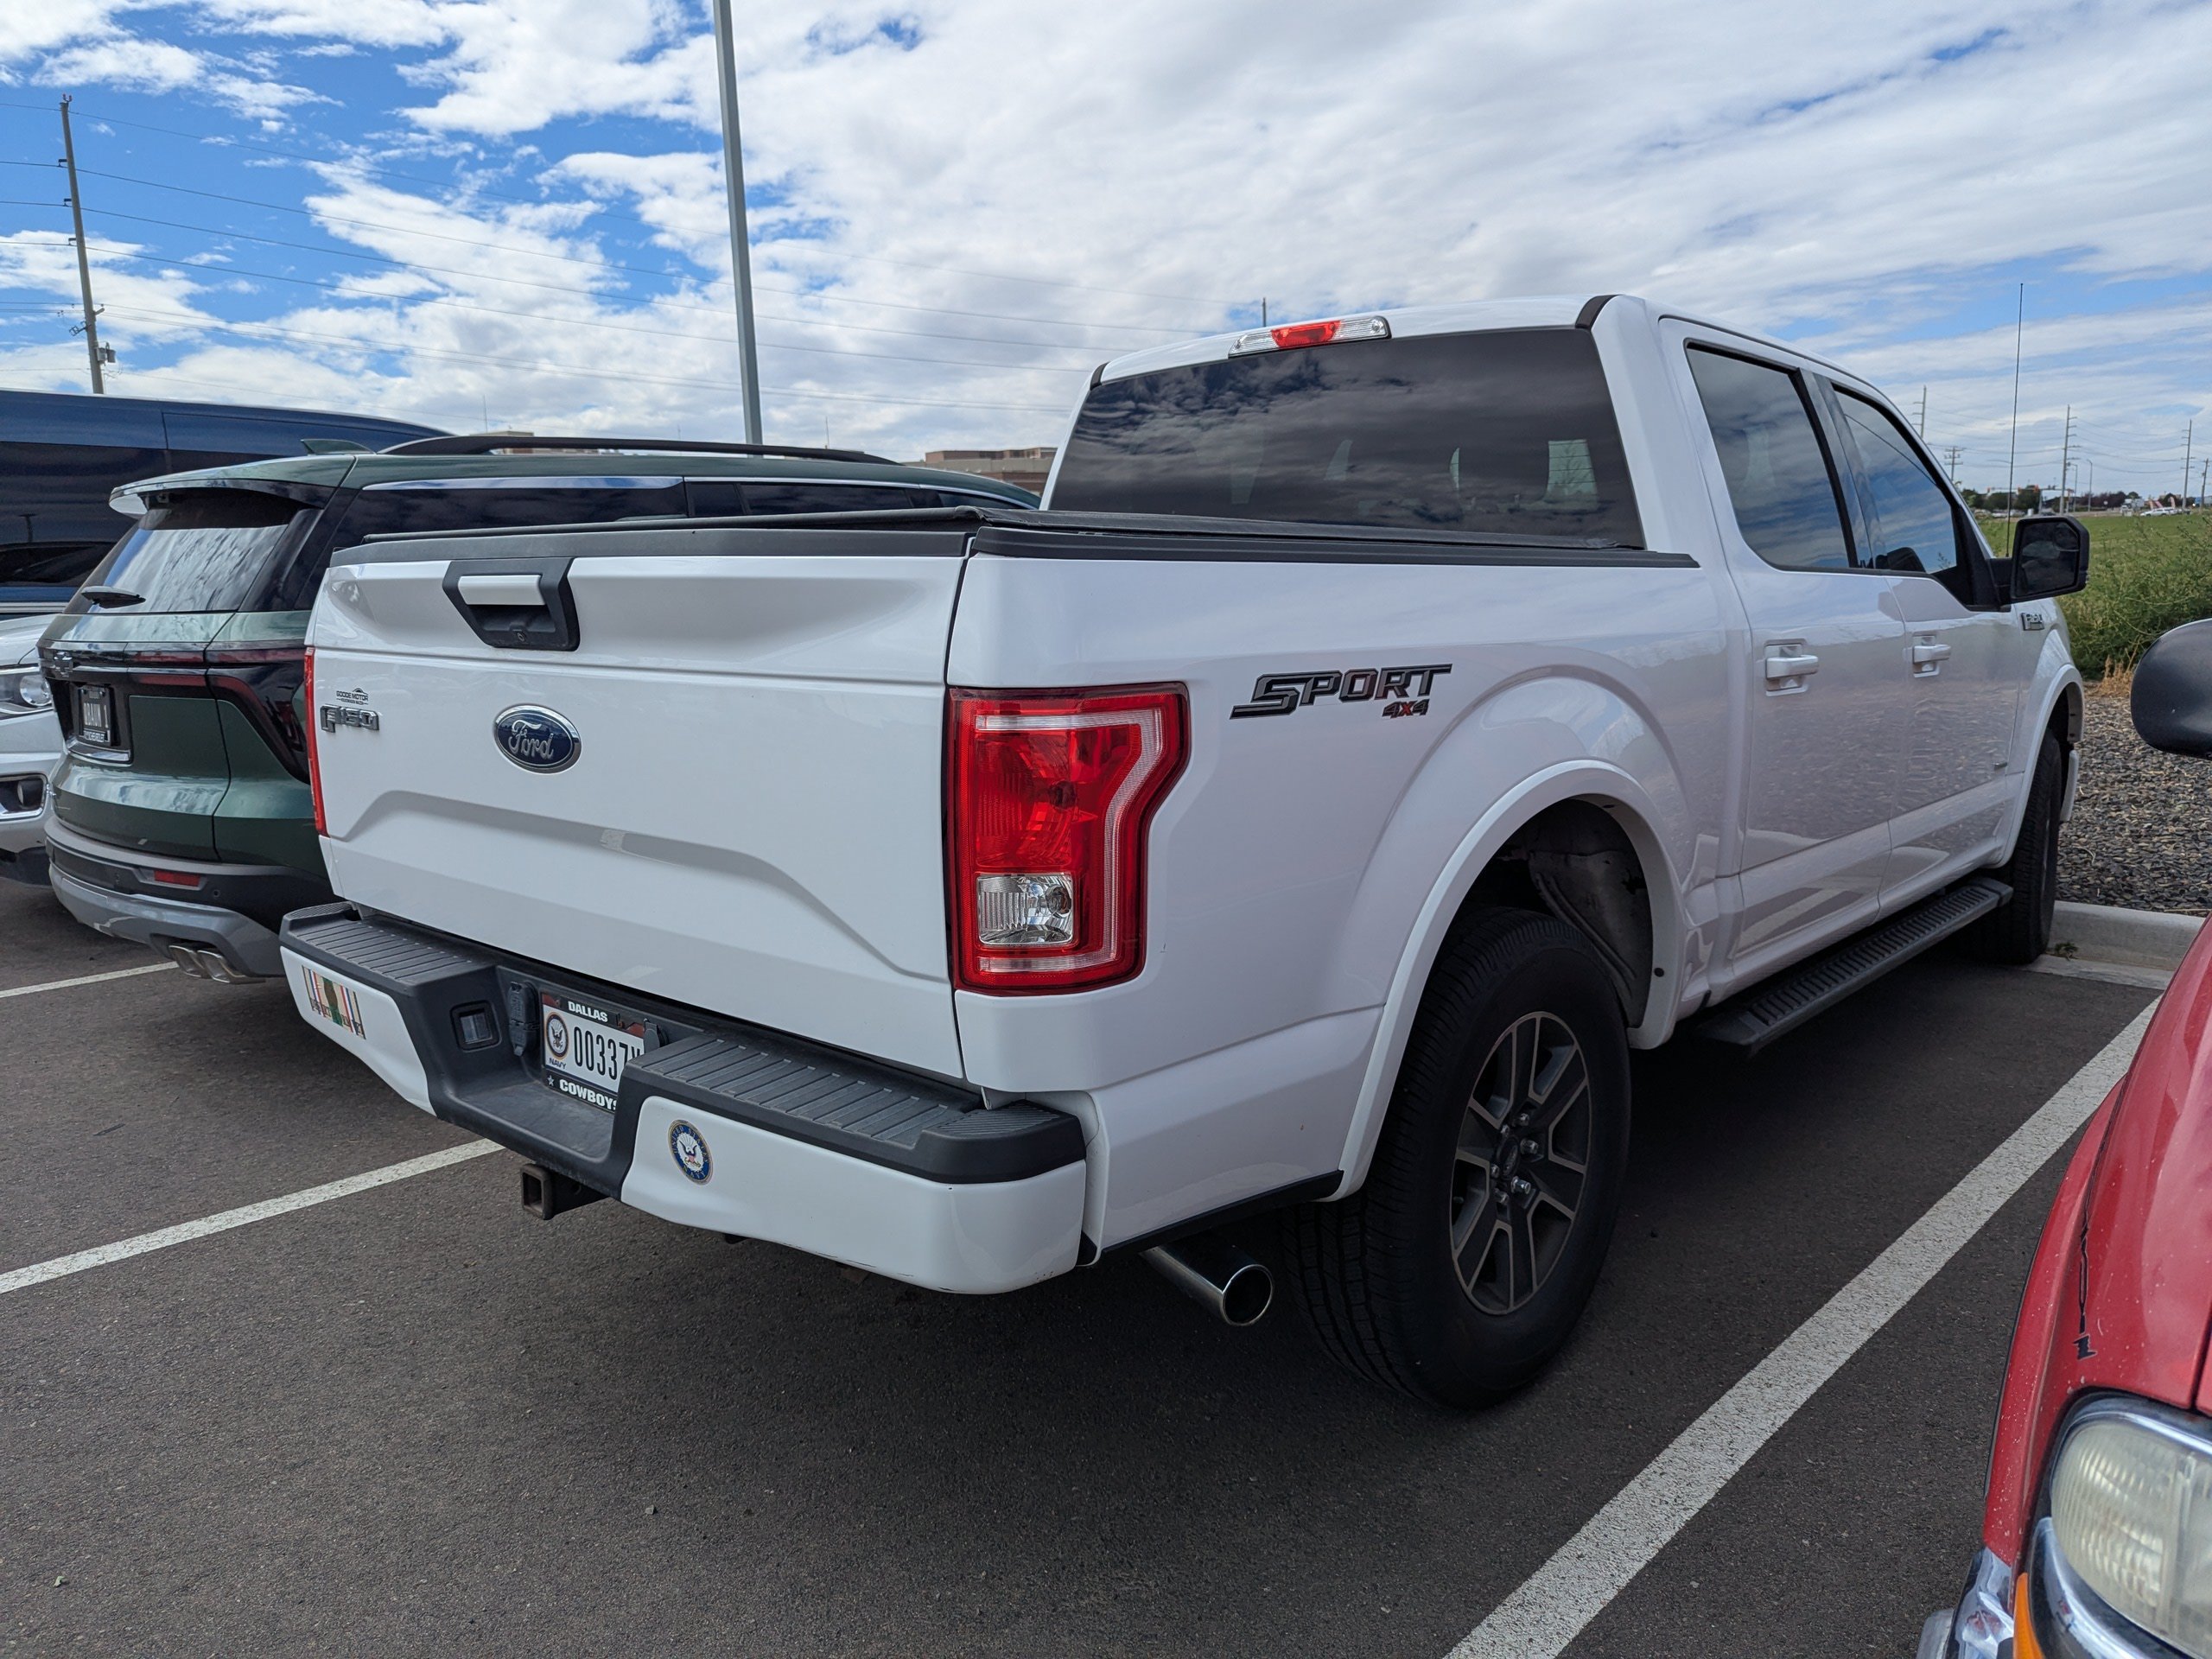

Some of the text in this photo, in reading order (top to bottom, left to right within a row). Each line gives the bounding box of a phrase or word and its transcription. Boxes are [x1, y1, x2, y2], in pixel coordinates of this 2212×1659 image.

[1230, 664, 1452, 720] SPORT
[508, 719, 554, 760] Ford
[568, 1001, 608, 1023] DALLAS
[549, 1057, 567, 1070] NAVY
